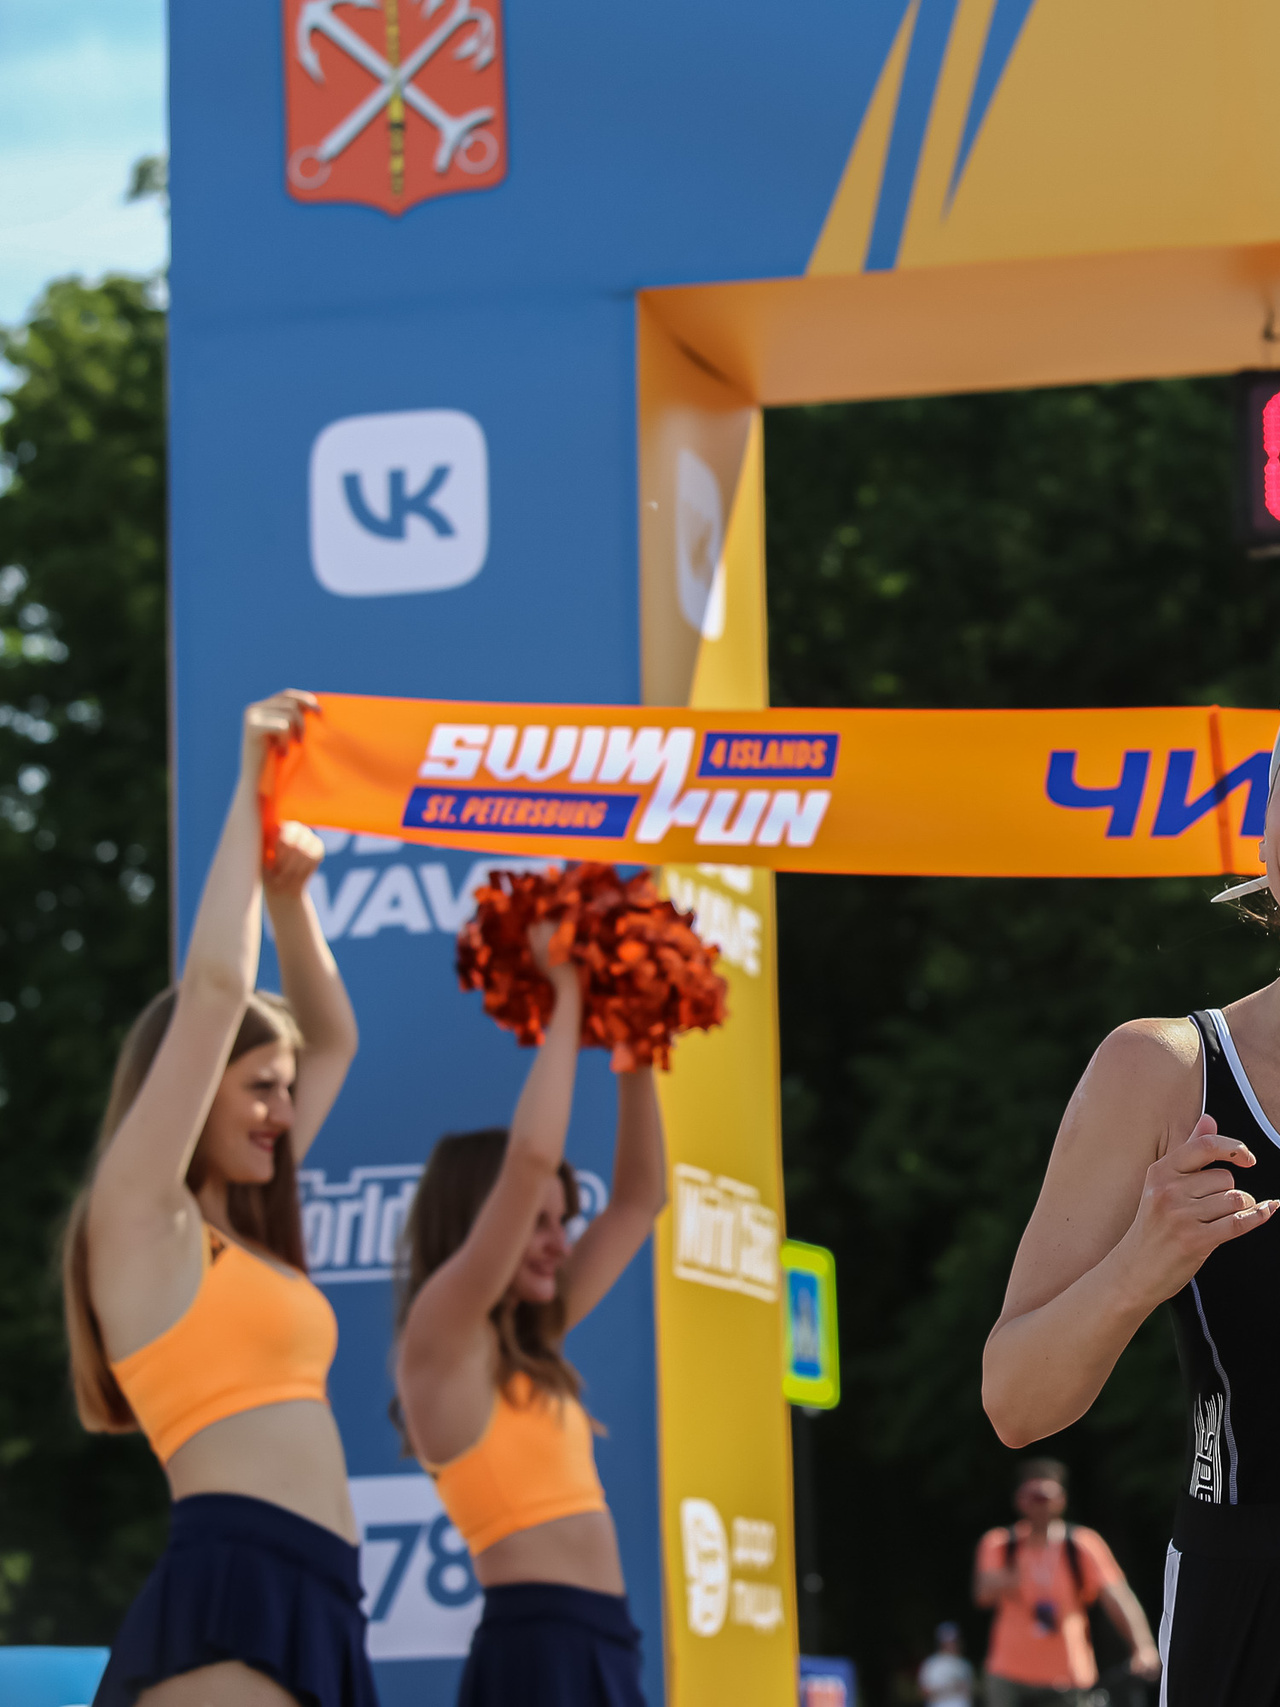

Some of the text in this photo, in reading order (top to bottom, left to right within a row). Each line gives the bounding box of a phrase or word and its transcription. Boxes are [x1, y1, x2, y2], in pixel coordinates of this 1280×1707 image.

[341, 464, 456, 542] VK
[419, 723, 696, 784] SWIM
[709, 740, 829, 770] 4 ISLANDS
[421, 795, 609, 829] ST. PETERSBURG
